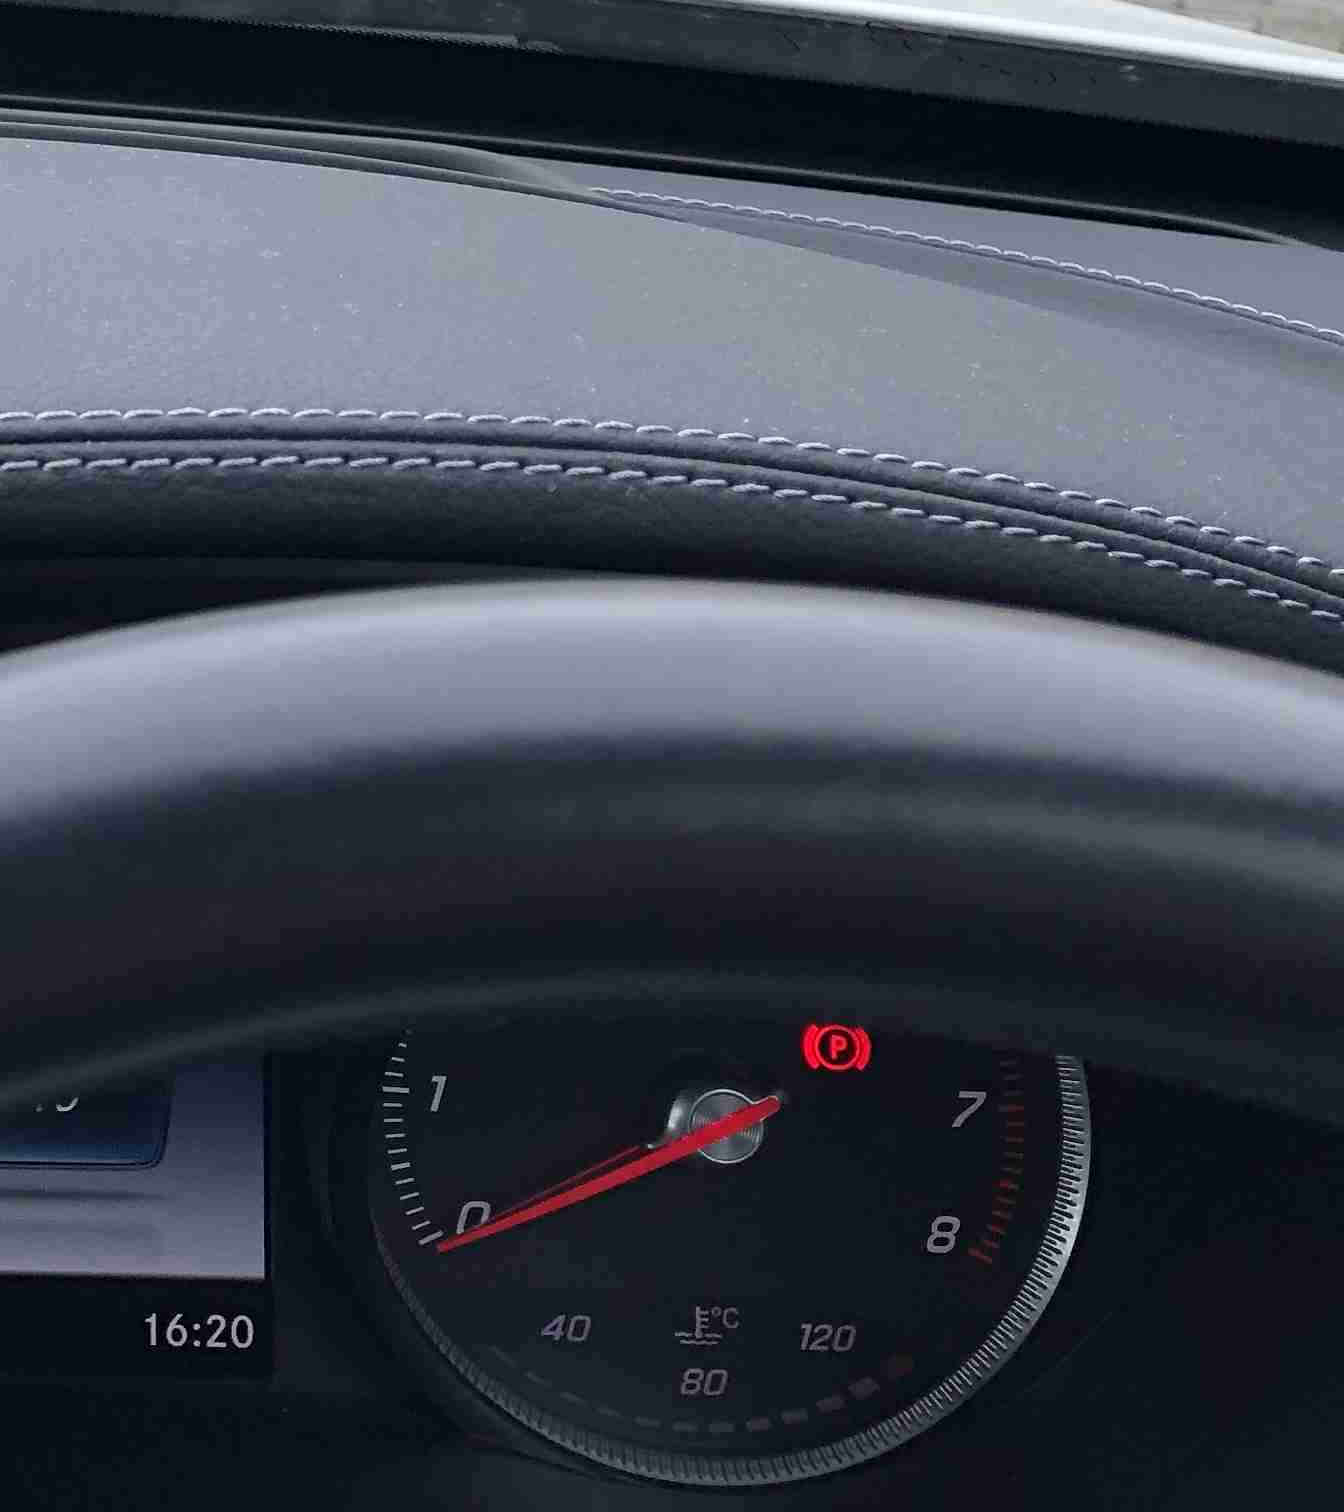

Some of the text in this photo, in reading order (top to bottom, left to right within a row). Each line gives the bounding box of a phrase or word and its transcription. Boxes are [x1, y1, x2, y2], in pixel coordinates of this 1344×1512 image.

[427, 1074, 448, 1113] 1
[951, 1090, 987, 1128] 7
[455, 1200, 491, 1235] 0
[925, 1215, 961, 1254] 8
[144, 1313, 255, 1349] 16:20
[540, 1314, 592, 1343] 40
[799, 1322, 857, 1352] 120
[679, 1368, 728, 1396] 80
